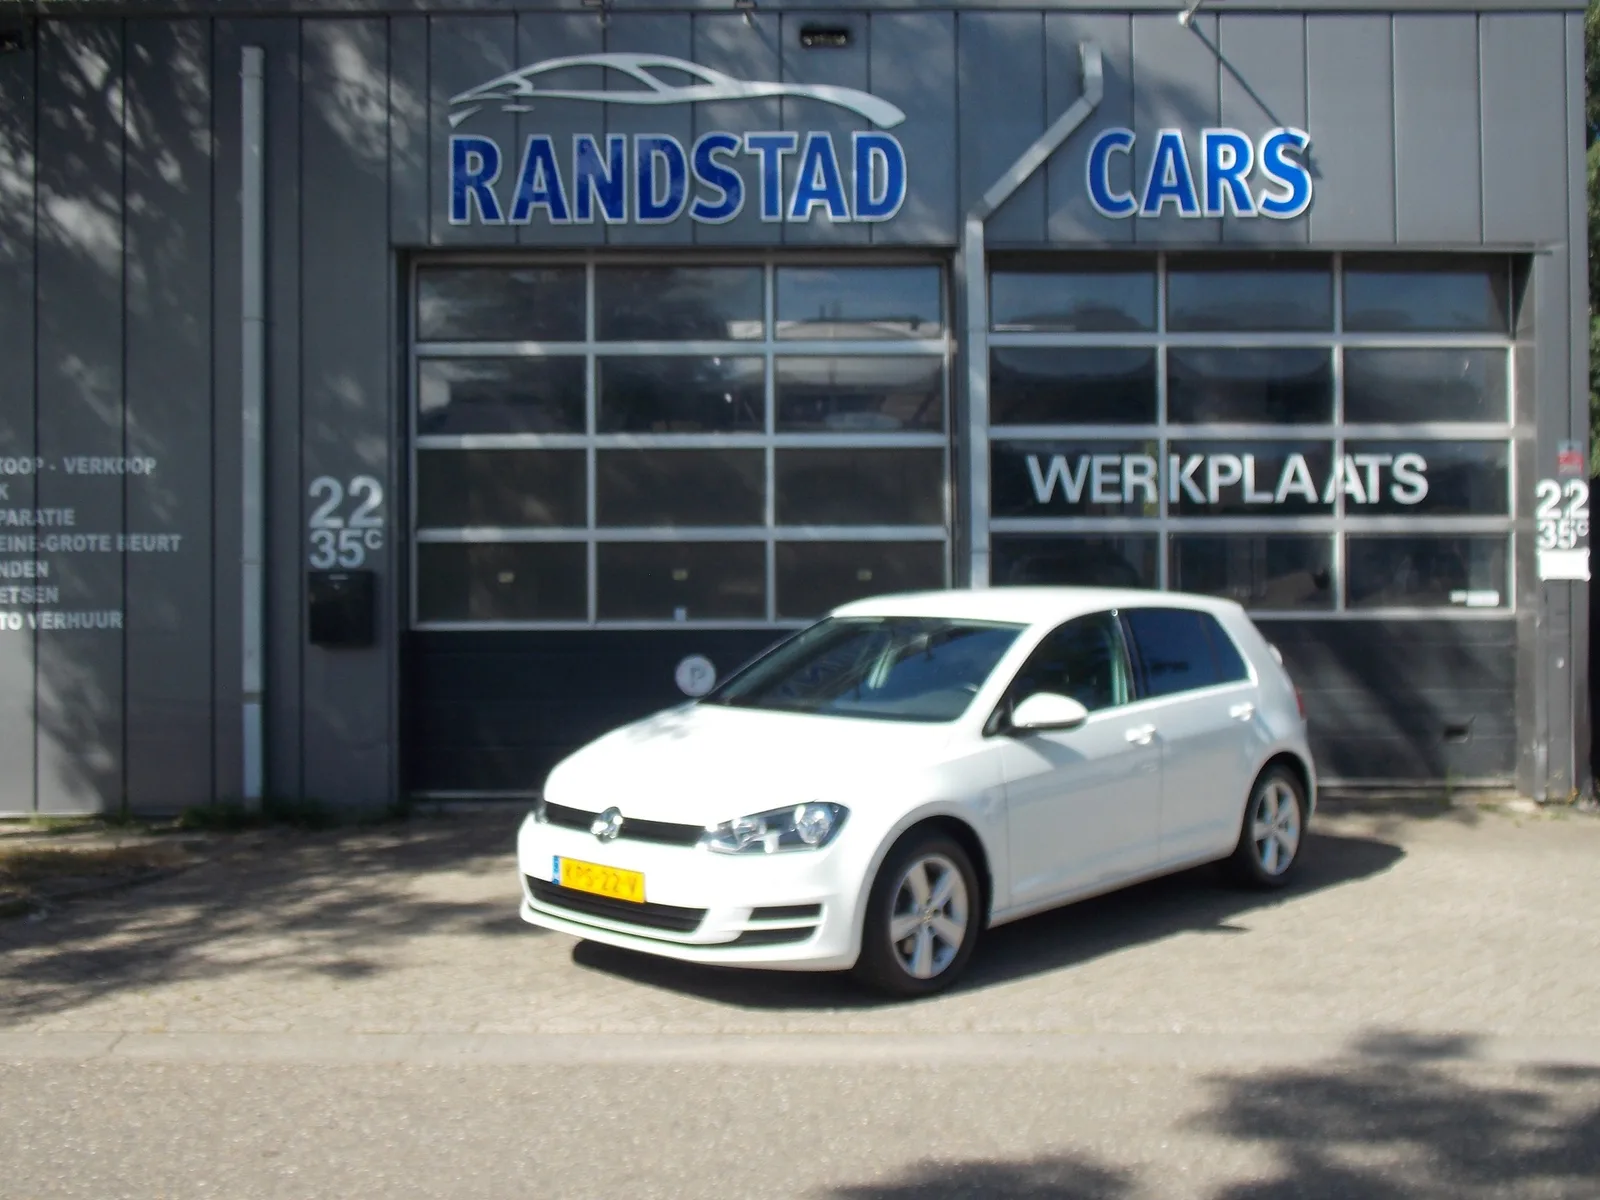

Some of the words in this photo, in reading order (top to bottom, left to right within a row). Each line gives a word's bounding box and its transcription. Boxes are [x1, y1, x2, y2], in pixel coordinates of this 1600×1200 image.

[448, 131, 907, 224] RANDSTAD
[1086, 127, 1313, 220] CARS
[64, 457, 157, 475] VERKOOP
[1025, 453, 1429, 505] WERKPLAATS
[309, 475, 384, 529] 22
[1536, 478, 1590, 520] 22
[27, 611, 124, 630] VERHUUR
